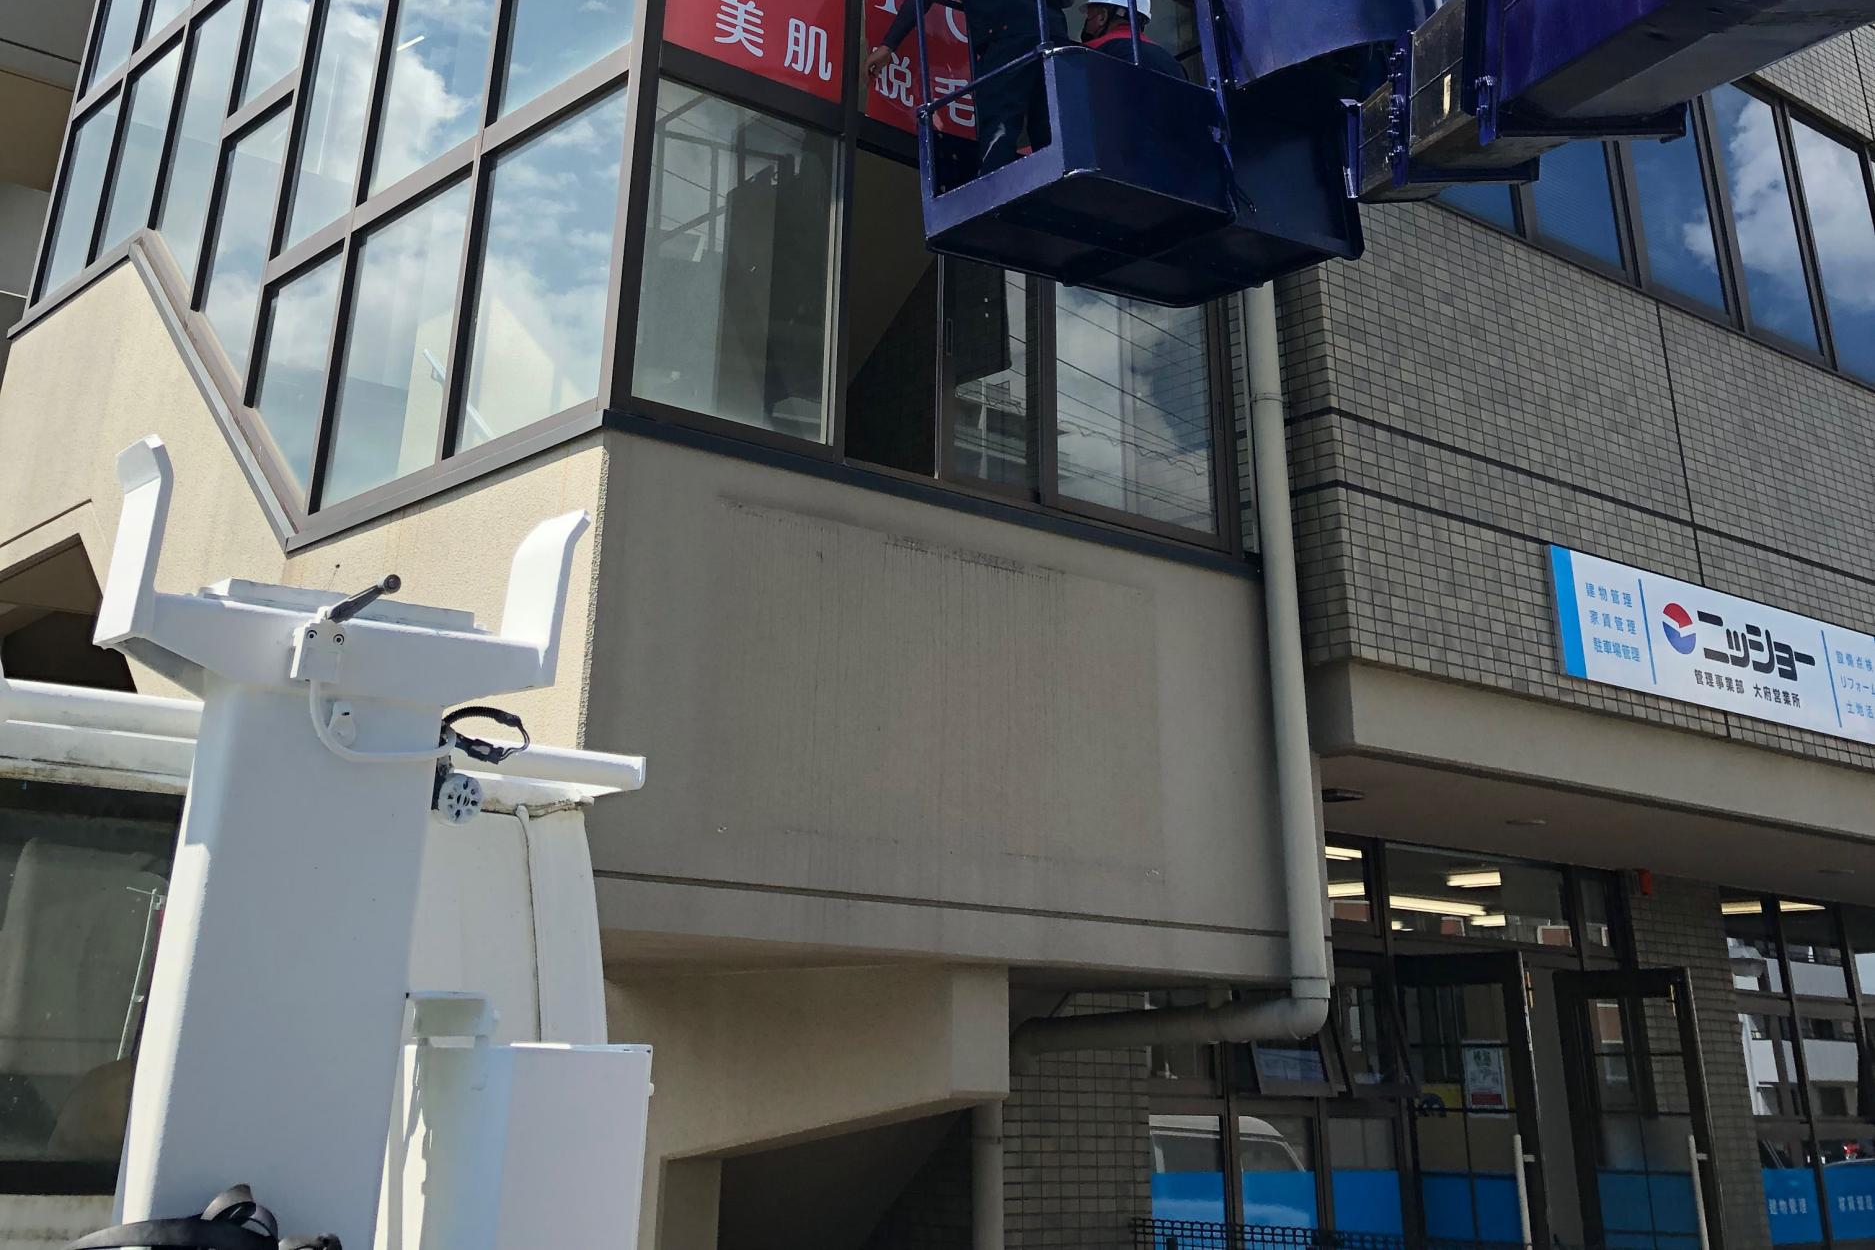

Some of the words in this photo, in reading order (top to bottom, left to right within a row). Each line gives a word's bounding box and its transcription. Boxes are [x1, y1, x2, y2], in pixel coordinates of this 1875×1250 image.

[1585, 582, 1633, 608] 建物管理
[1589, 610, 1637, 635] 家賃管理
[1593, 637, 1641, 662] 駐車場管理
[1697, 610, 1816, 682] ニッショー
[1694, 669, 1745, 694] 管理事業部
[1753, 683, 1801, 709] 大府営業所
